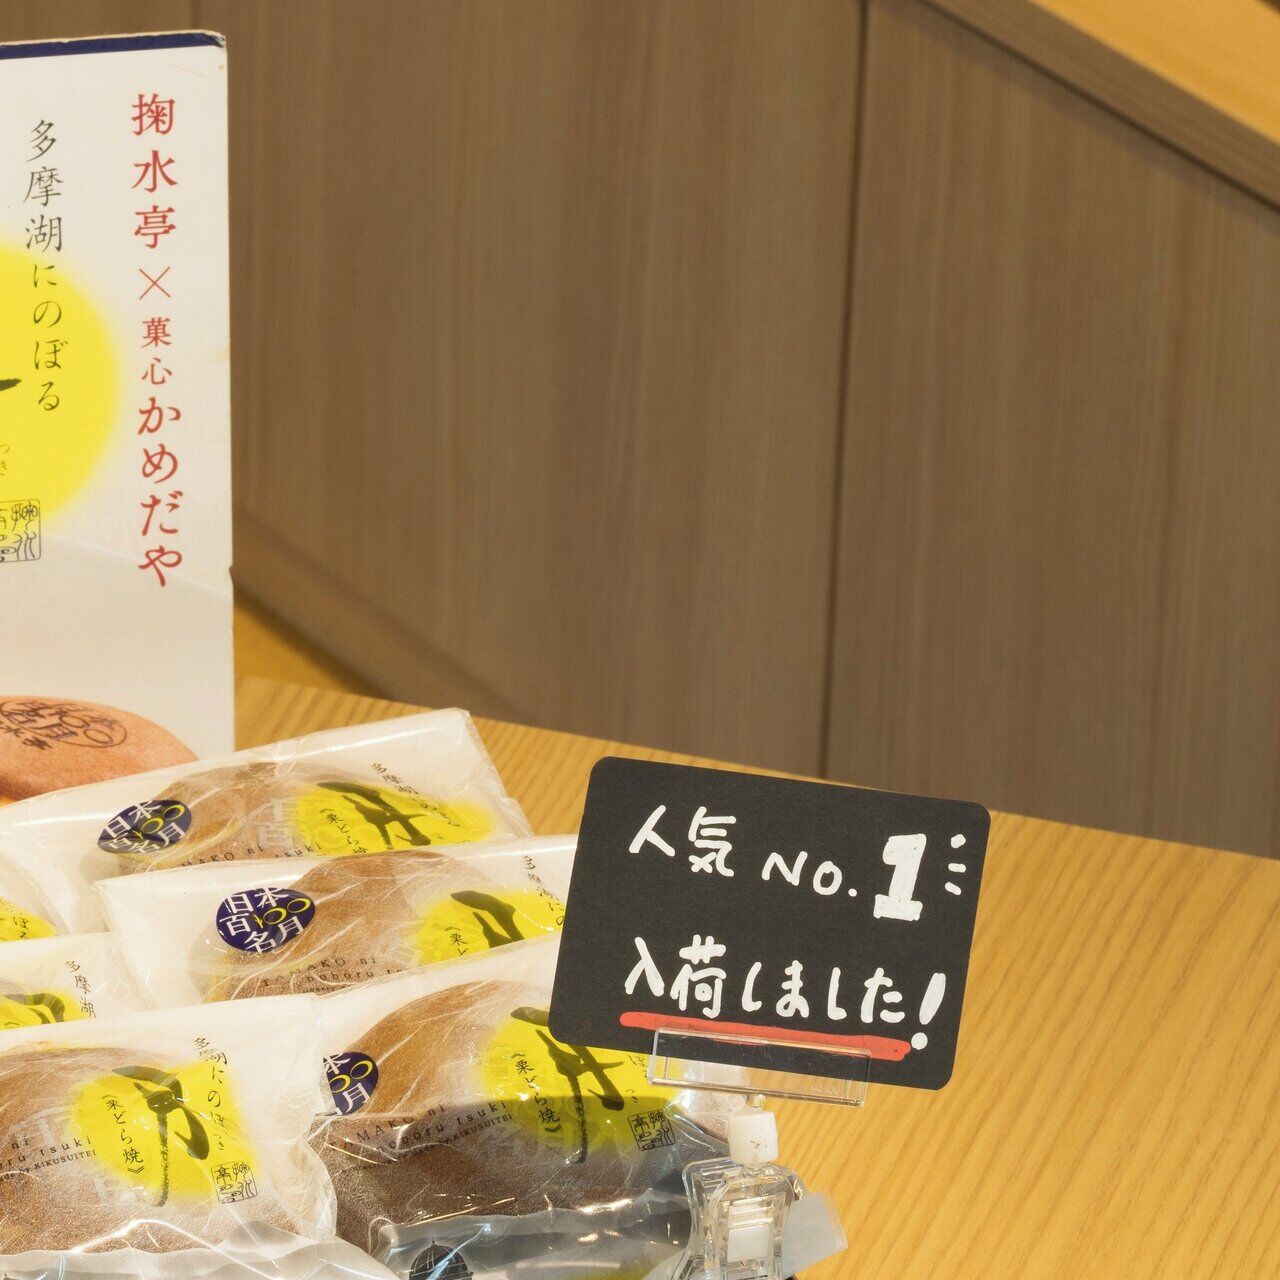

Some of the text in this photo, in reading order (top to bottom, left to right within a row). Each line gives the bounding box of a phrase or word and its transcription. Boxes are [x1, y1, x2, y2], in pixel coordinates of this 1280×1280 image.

[23, 118, 70, 412] 多摩湖にのぼる
